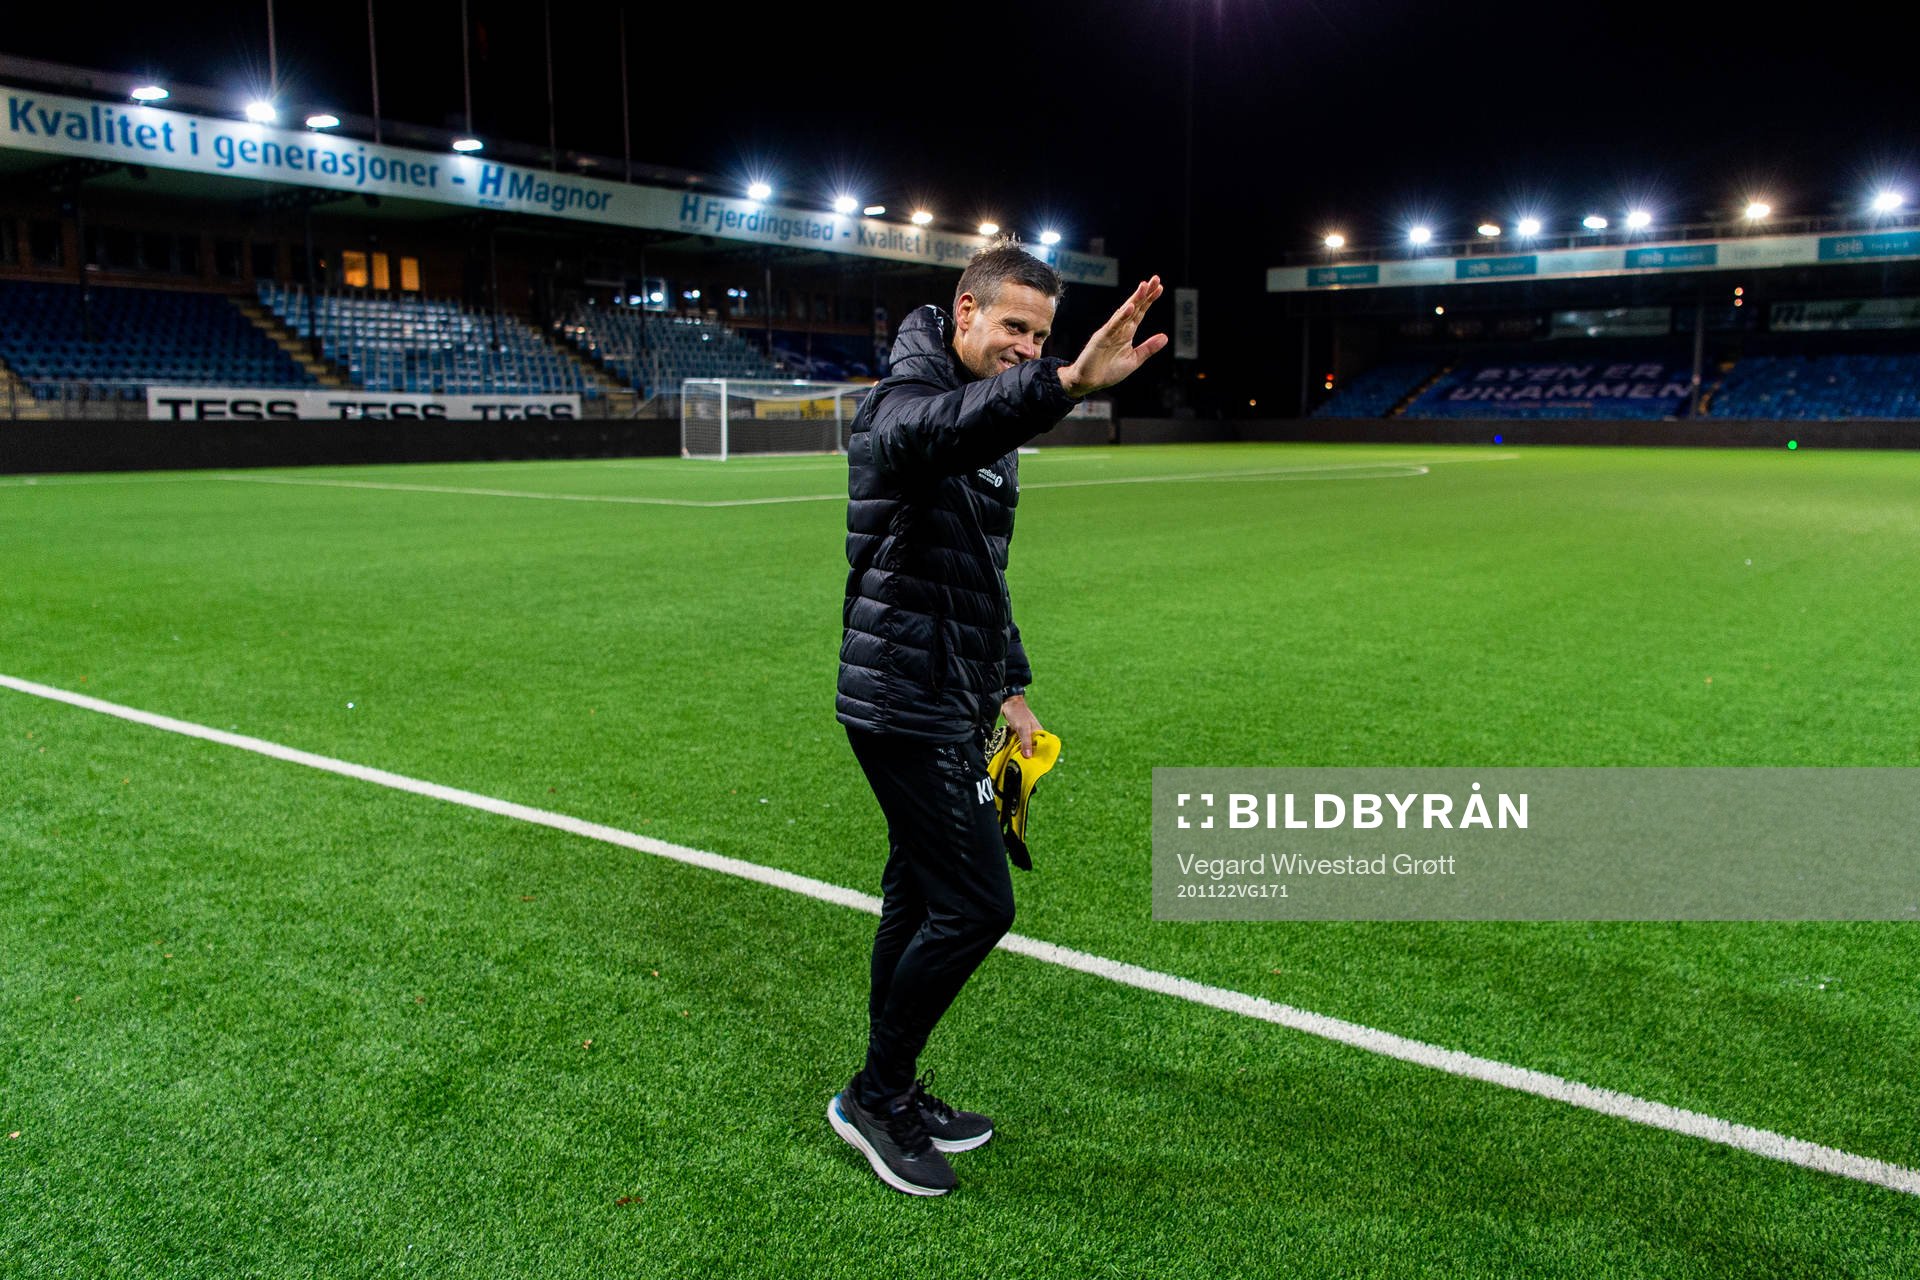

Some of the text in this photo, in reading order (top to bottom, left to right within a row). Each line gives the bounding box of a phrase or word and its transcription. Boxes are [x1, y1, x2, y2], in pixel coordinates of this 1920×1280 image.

[8, 97, 175, 153] Kvalitet
[189, 121, 199, 155] i
[213, 135, 439, 188] generasjoner
[508, 172, 614, 212] Magnor
[704, 201, 834, 241] Fjerdingstad
[857, 227, 921, 255] Kvalitet
[157, 398, 299, 420] TESS
